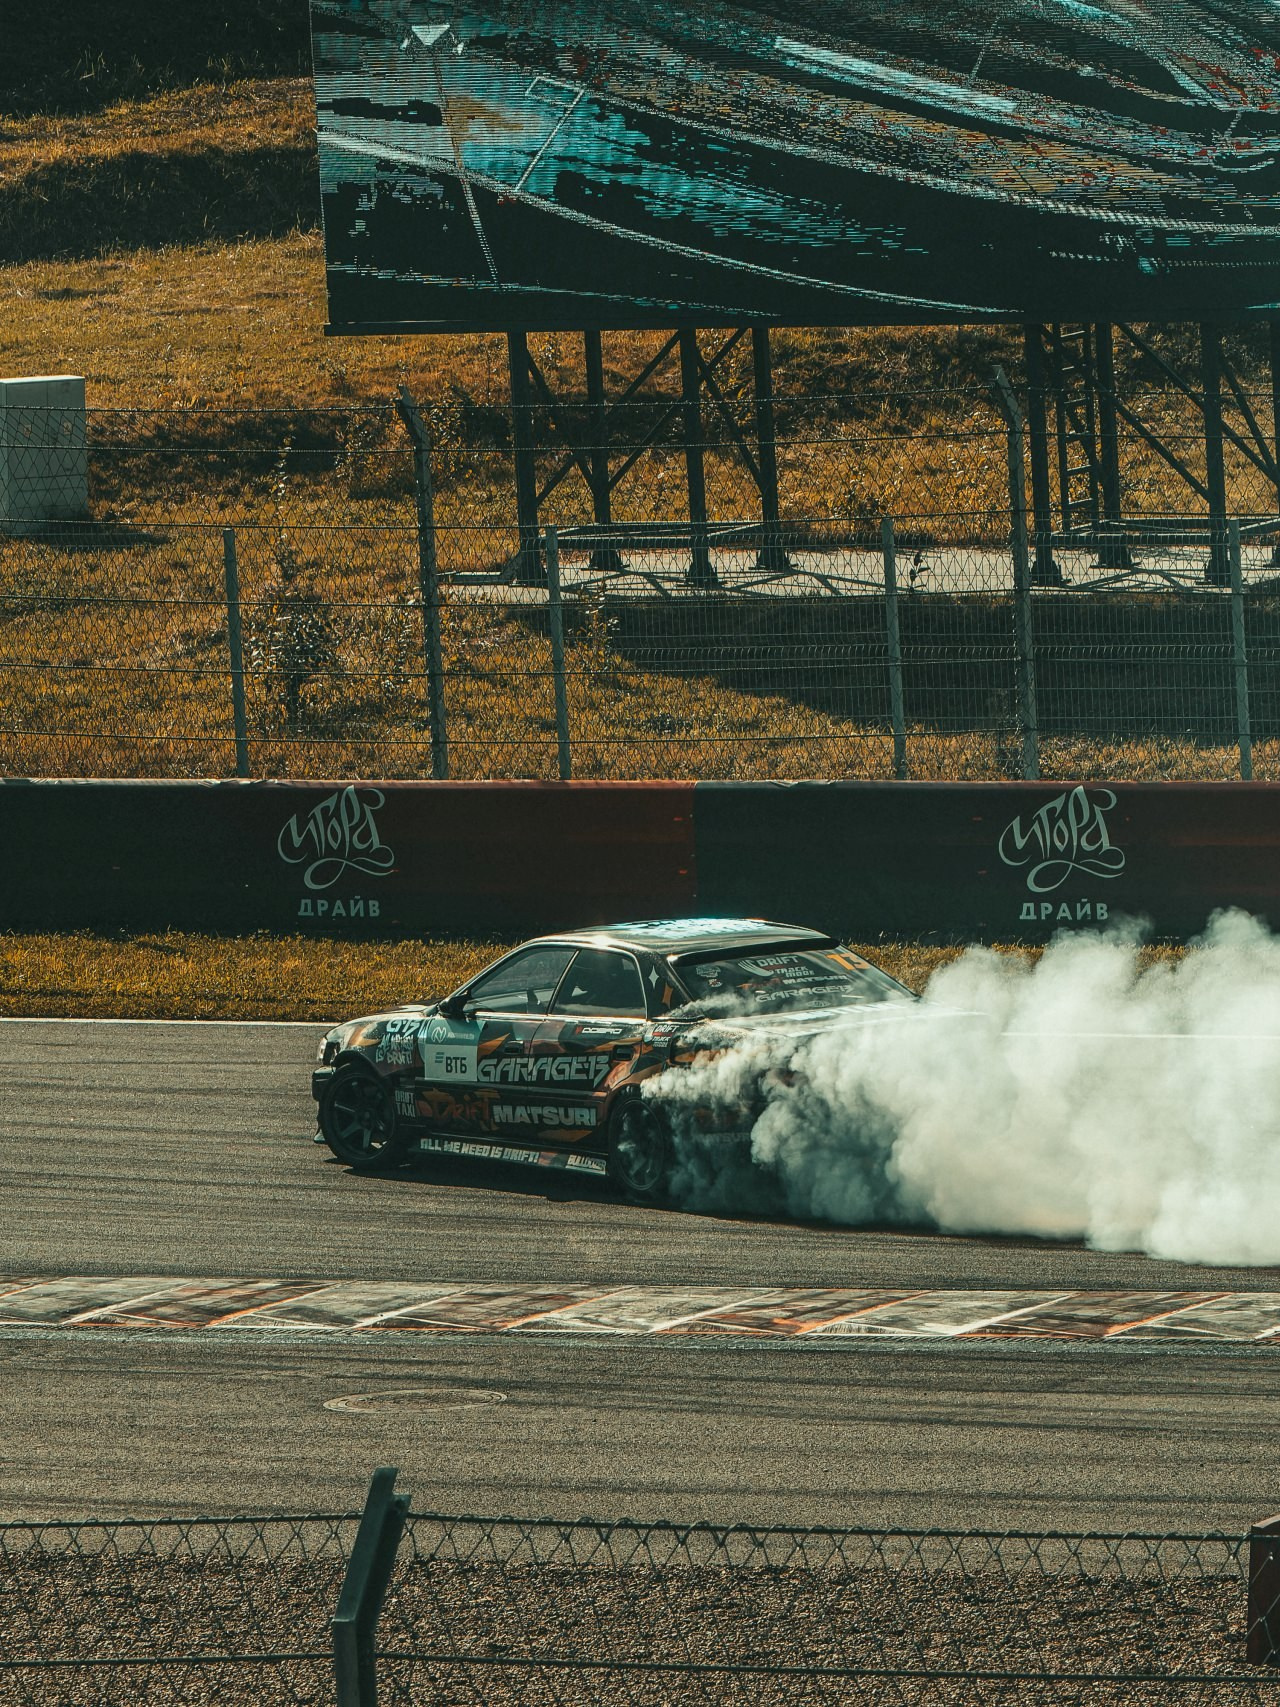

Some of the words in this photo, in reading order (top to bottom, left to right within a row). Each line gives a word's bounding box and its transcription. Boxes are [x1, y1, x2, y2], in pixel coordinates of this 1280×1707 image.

[298, 896, 380, 917] ДРАЙВ
[1020, 898, 1108, 921] ДРАЙВ
[755, 954, 801, 967] DRIFT
[826, 953, 871, 971] 13
[655, 1025, 680, 1034] DRIFT
[446, 1056, 467, 1074] ВТБ
[394, 1089, 415, 1104] DRIFT
[396, 1102, 416, 1119] TAXI
[492, 1105, 597, 1127] MATSURI
[420, 1138, 442, 1152] ALL
[443, 1141, 460, 1154] WE
[461, 1143, 489, 1157] NEED
[490, 1146, 502, 1159] IS
[502, 1147, 540, 1164] DRIFT!
